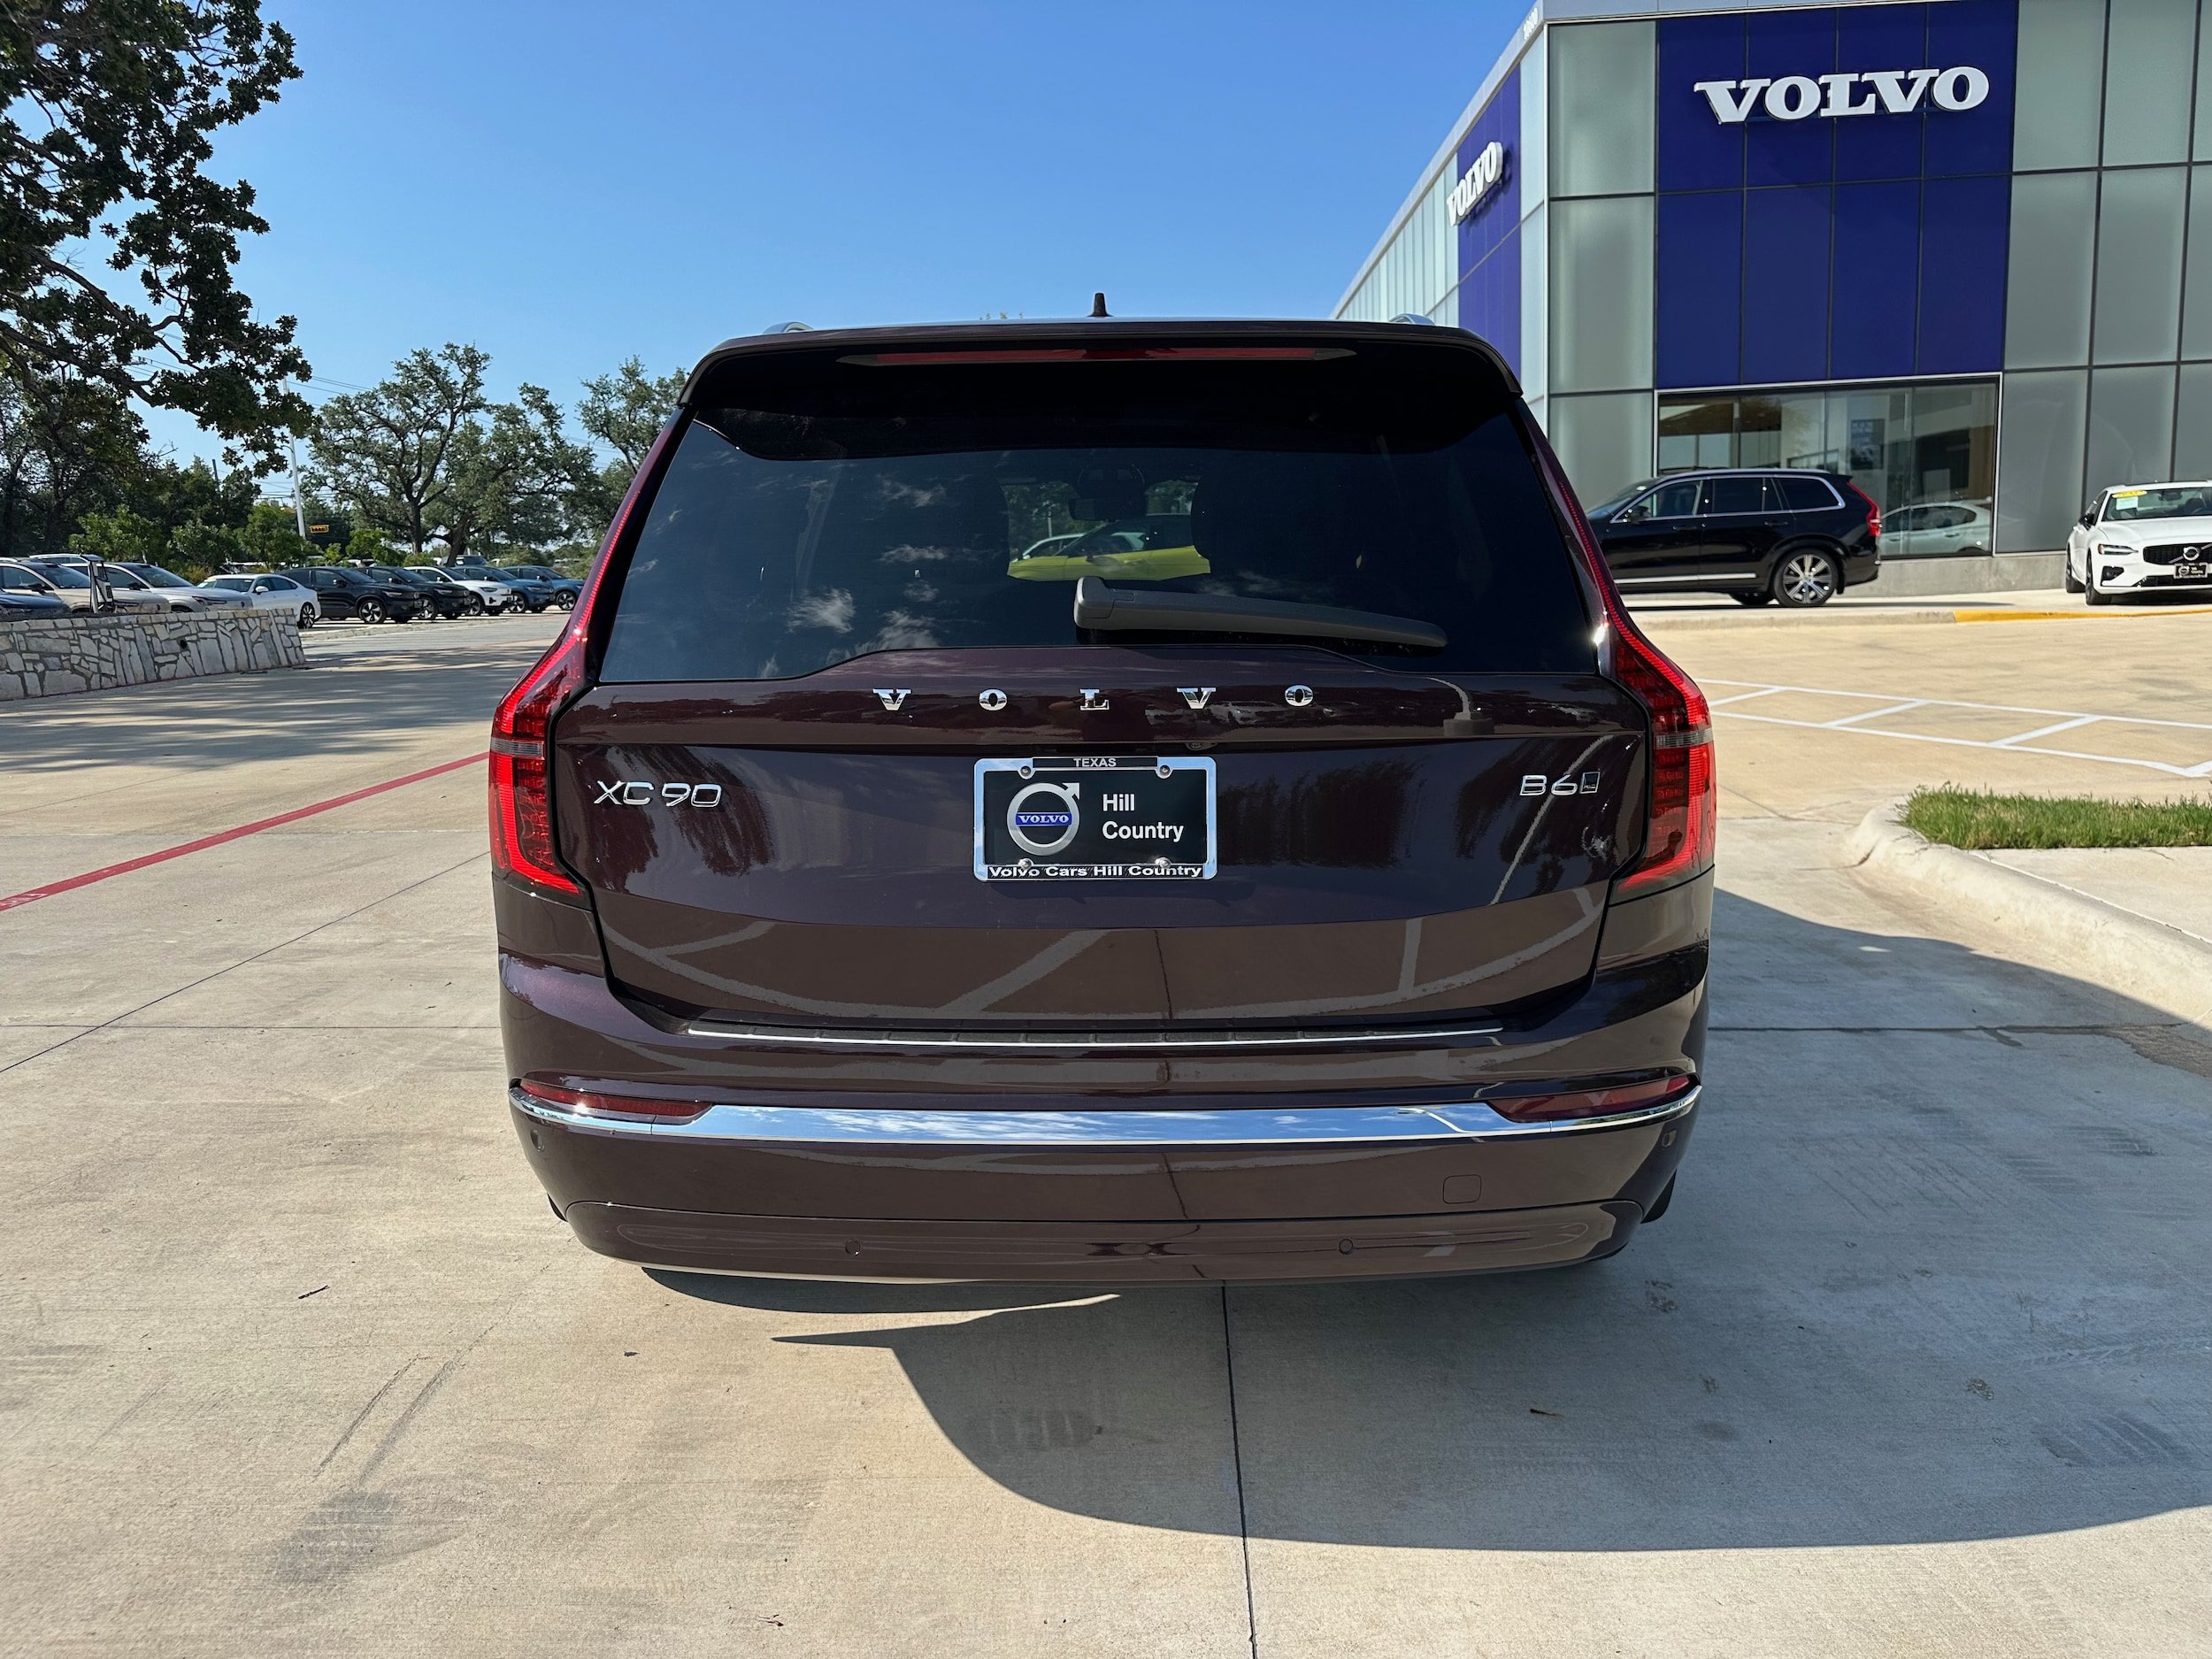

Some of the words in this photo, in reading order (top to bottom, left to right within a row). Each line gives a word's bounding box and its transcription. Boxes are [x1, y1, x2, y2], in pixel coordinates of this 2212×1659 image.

[1694, 66, 1989, 125] VOLVO
[1447, 142, 1502, 227] VOLVO
[872, 684, 1314, 711] VOLVO
[1073, 757, 1117, 767] TEXAS
[1102, 794, 1135, 811] Hill
[1018, 815, 1069, 824] VOLVO
[1102, 820, 1184, 841] Country
[988, 866, 1041, 877] Volvo
[1044, 865, 1087, 877] Cars
[1094, 865, 1123, 876] Hill
[1128, 865, 1202, 879] Country
